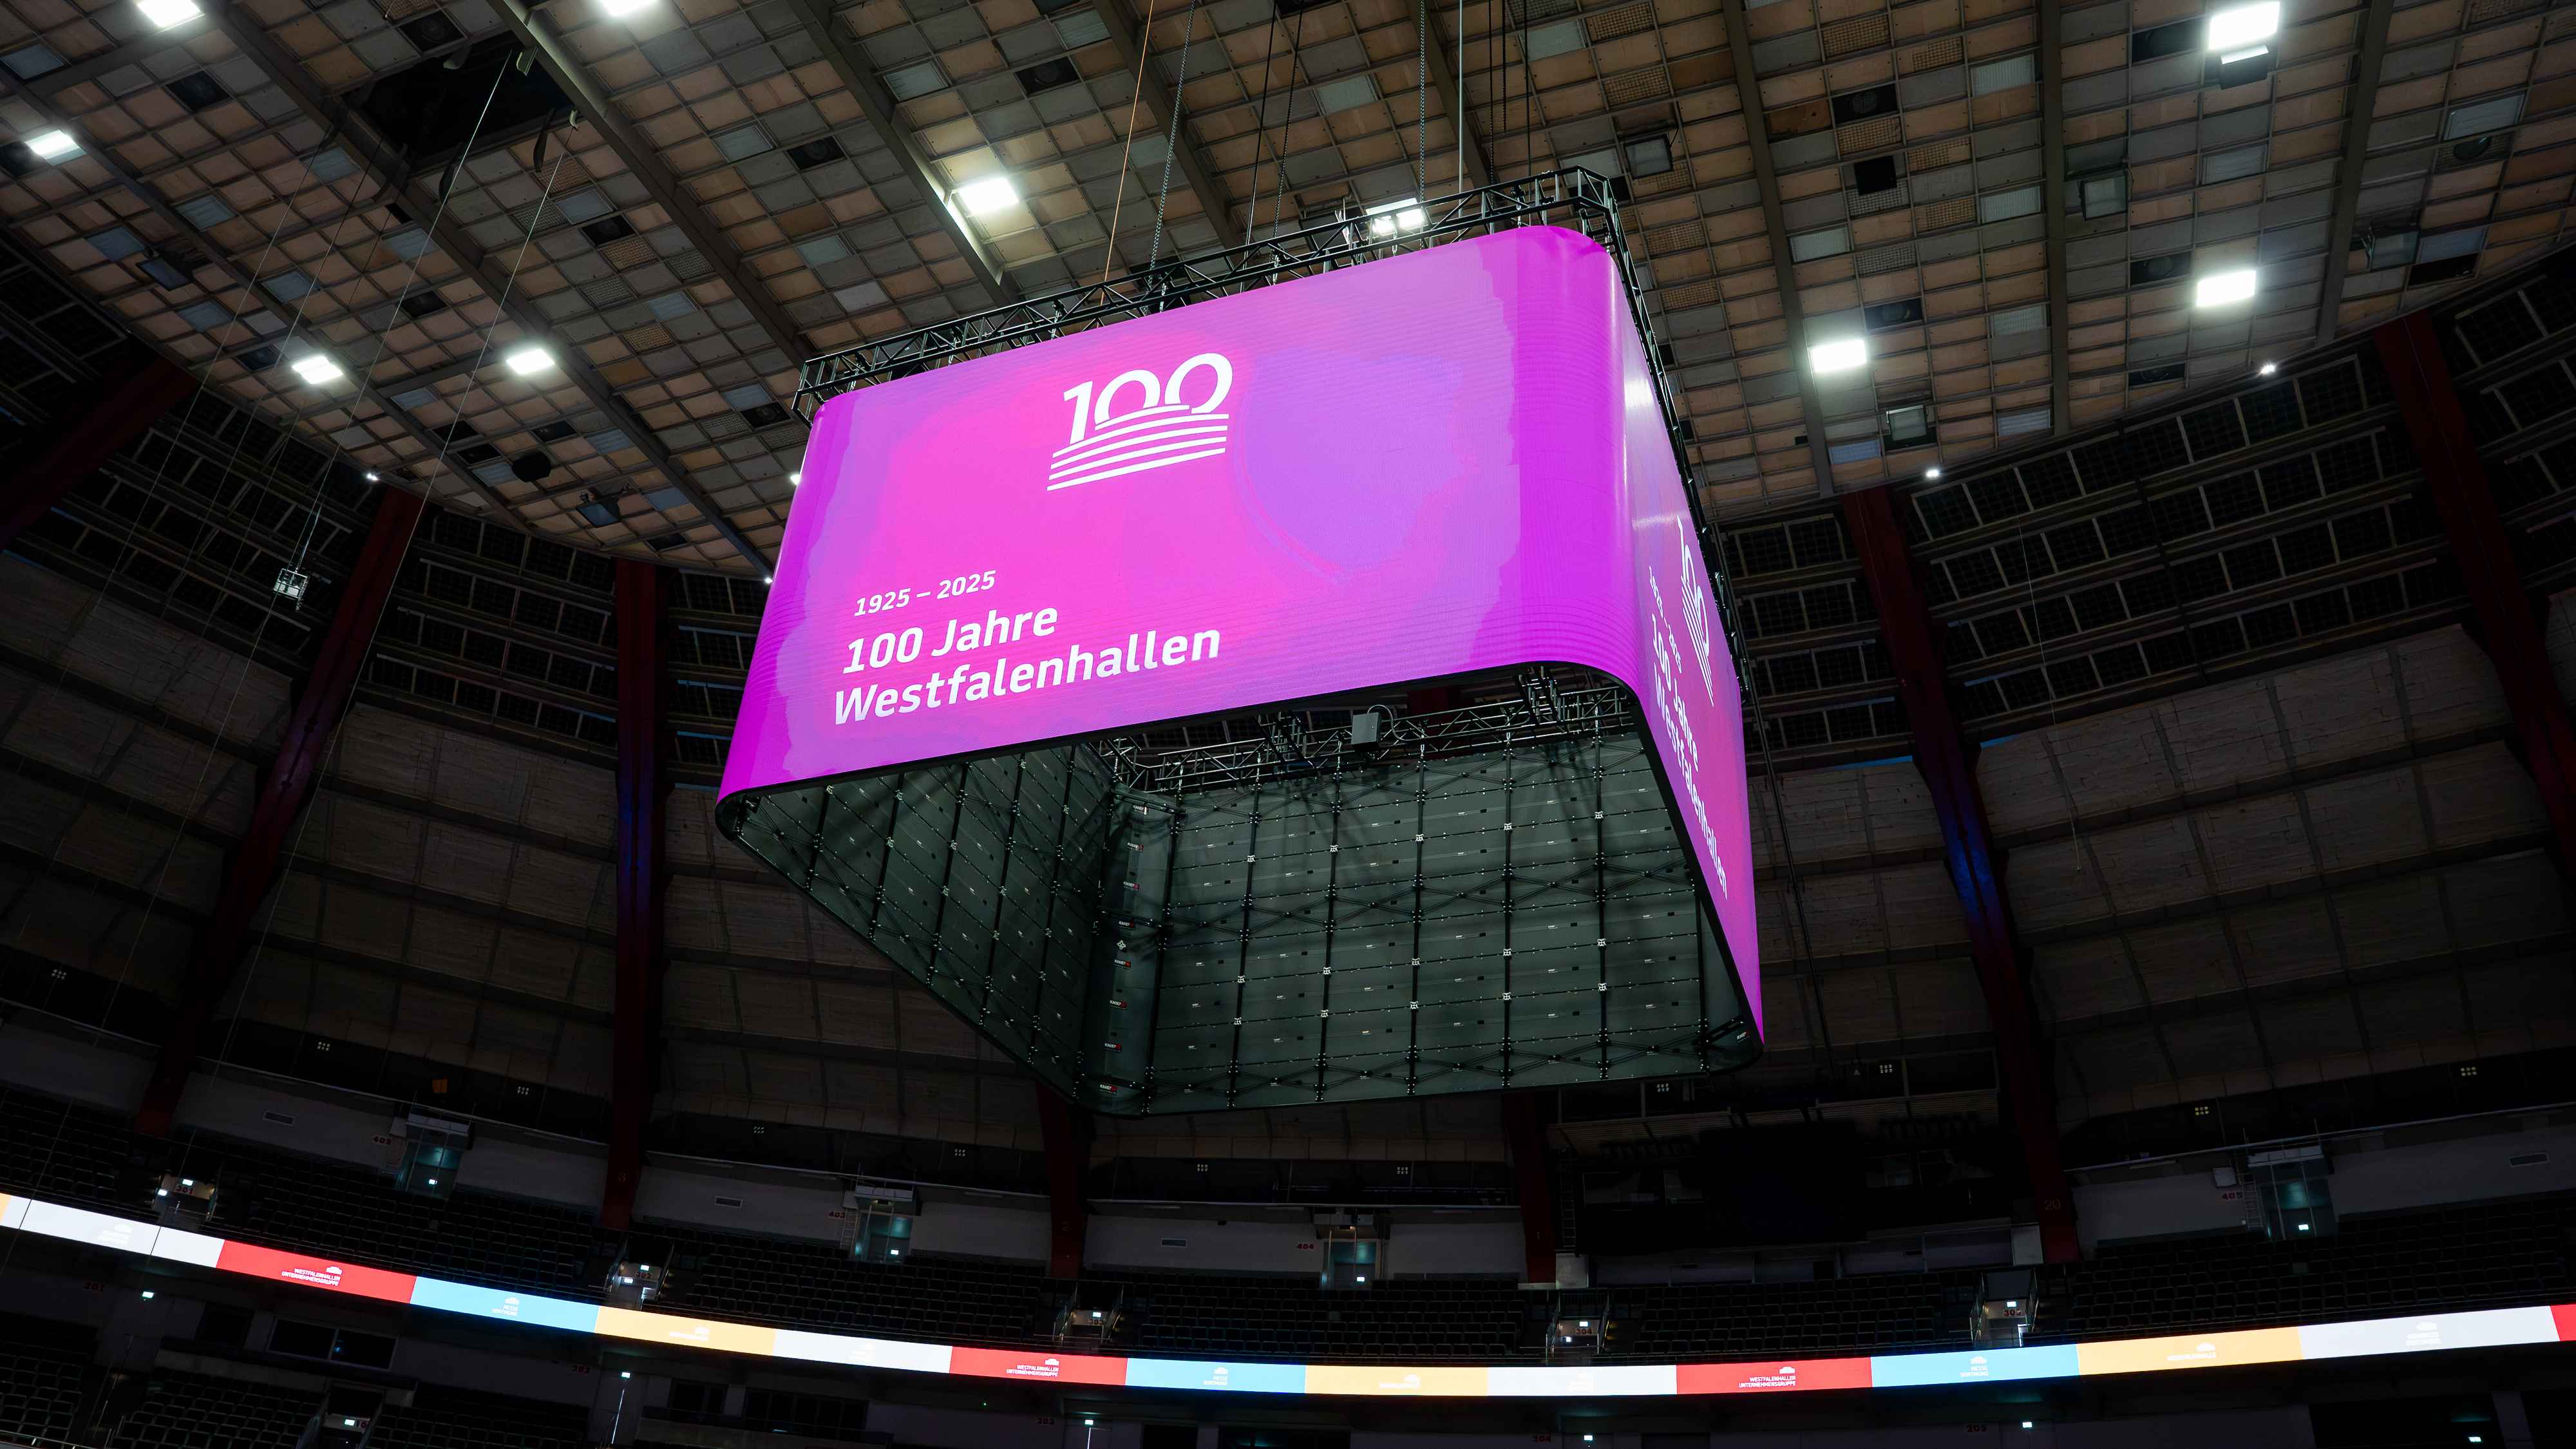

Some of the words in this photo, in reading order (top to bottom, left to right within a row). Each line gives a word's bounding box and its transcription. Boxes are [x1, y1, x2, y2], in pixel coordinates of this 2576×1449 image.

[1063, 354, 1233, 444] 100
[842, 627, 924, 675] 100
[931, 607, 1059, 658] Jahre
[853, 588, 912, 616] 1925
[936, 569, 997, 600] 2025
[1649, 565, 1663, 618] 1925
[1668, 623, 1682, 674] 2025
[835, 629, 1221, 726] Westfalenhallen
[1651, 613, 1672, 692] 100
[1672, 677, 1700, 773] Jahre
[1653, 661, 1728, 900] Westfalenhallen
